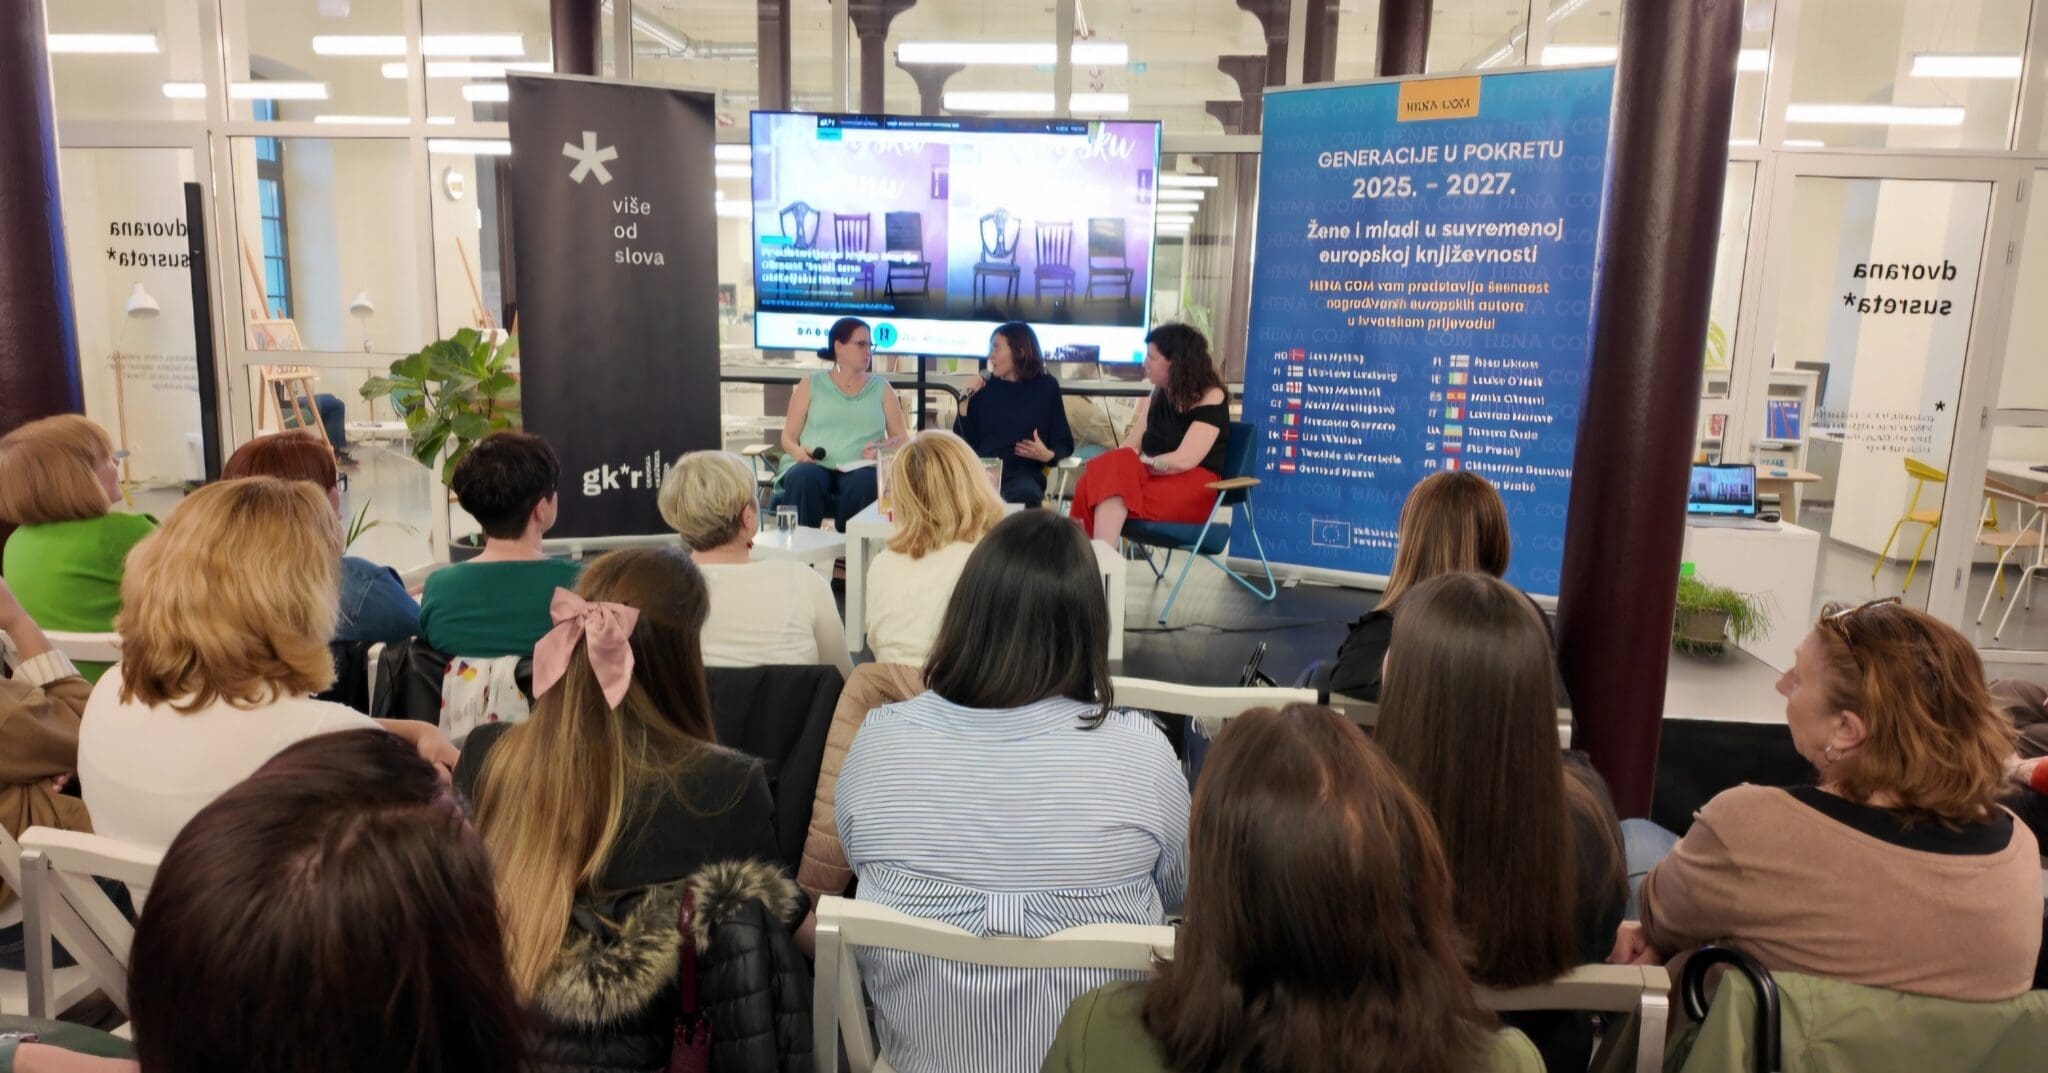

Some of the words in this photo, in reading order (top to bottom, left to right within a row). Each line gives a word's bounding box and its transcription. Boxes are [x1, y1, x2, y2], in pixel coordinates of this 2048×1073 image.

[1318, 146, 1439, 168] GENERACIJE
[1444, 145, 1458, 161] U
[1463, 140, 1564, 161] POKRETU
[1352, 176, 1417, 199] 2025.
[1446, 172, 1516, 196] 2027.
[612, 196, 651, 215] više
[614, 222, 637, 239] od
[1307, 218, 1350, 239] Žene
[1365, 219, 1419, 239] mladi
[1425, 223, 1436, 237] u
[1441, 218, 1564, 242] suvremenoj
[615, 246, 665, 266] slova
[1319, 245, 1409, 267] europskoj
[1415, 244, 1538, 268] književnosti
[1478, 301, 1525, 313] autora
[1347, 317, 1355, 326] u
